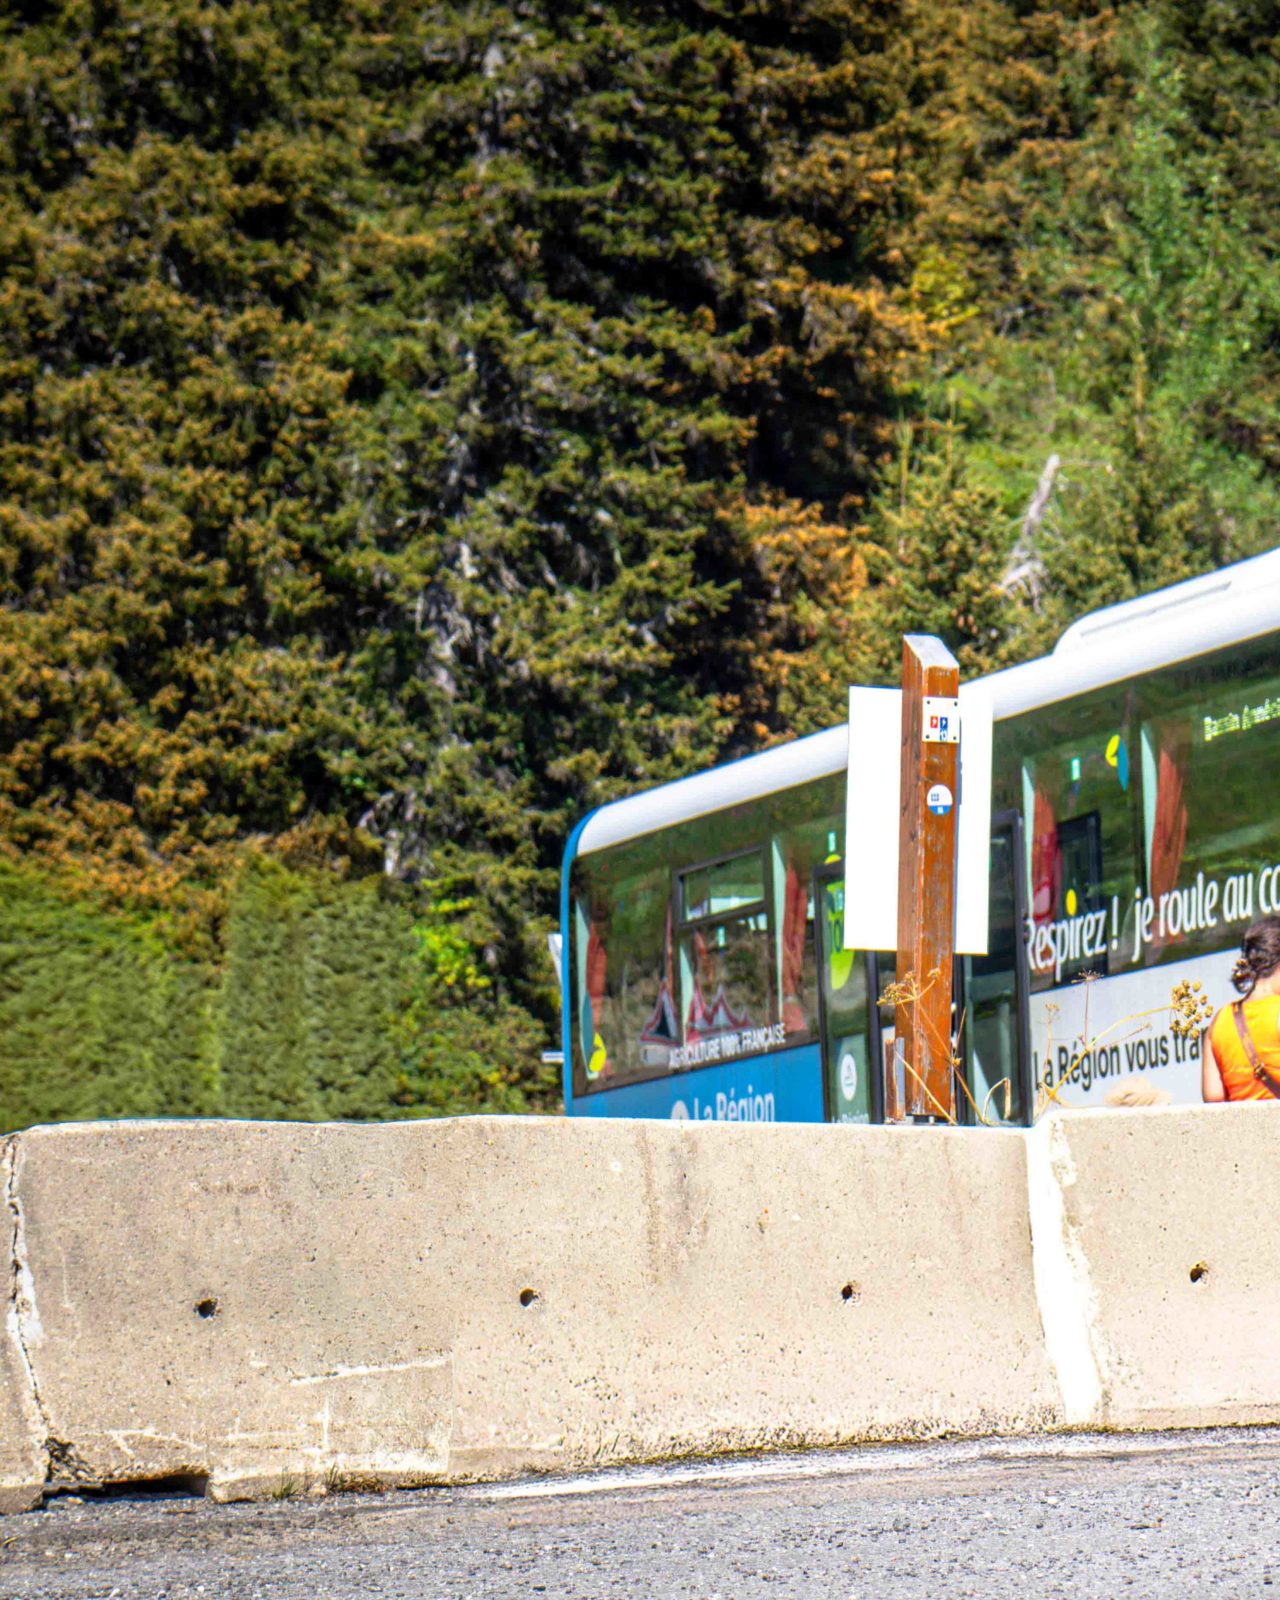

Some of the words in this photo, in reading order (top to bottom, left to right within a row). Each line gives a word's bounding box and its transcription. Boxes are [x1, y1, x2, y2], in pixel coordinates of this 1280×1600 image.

[1131, 886, 1154, 963] je
[1158, 871, 1219, 938] roule
[1222, 872, 1254, 923] au
[1033, 1051, 1053, 1091] La
[1058, 1037, 1121, 1092] Région
[1124, 1034, 1169, 1073] vous
